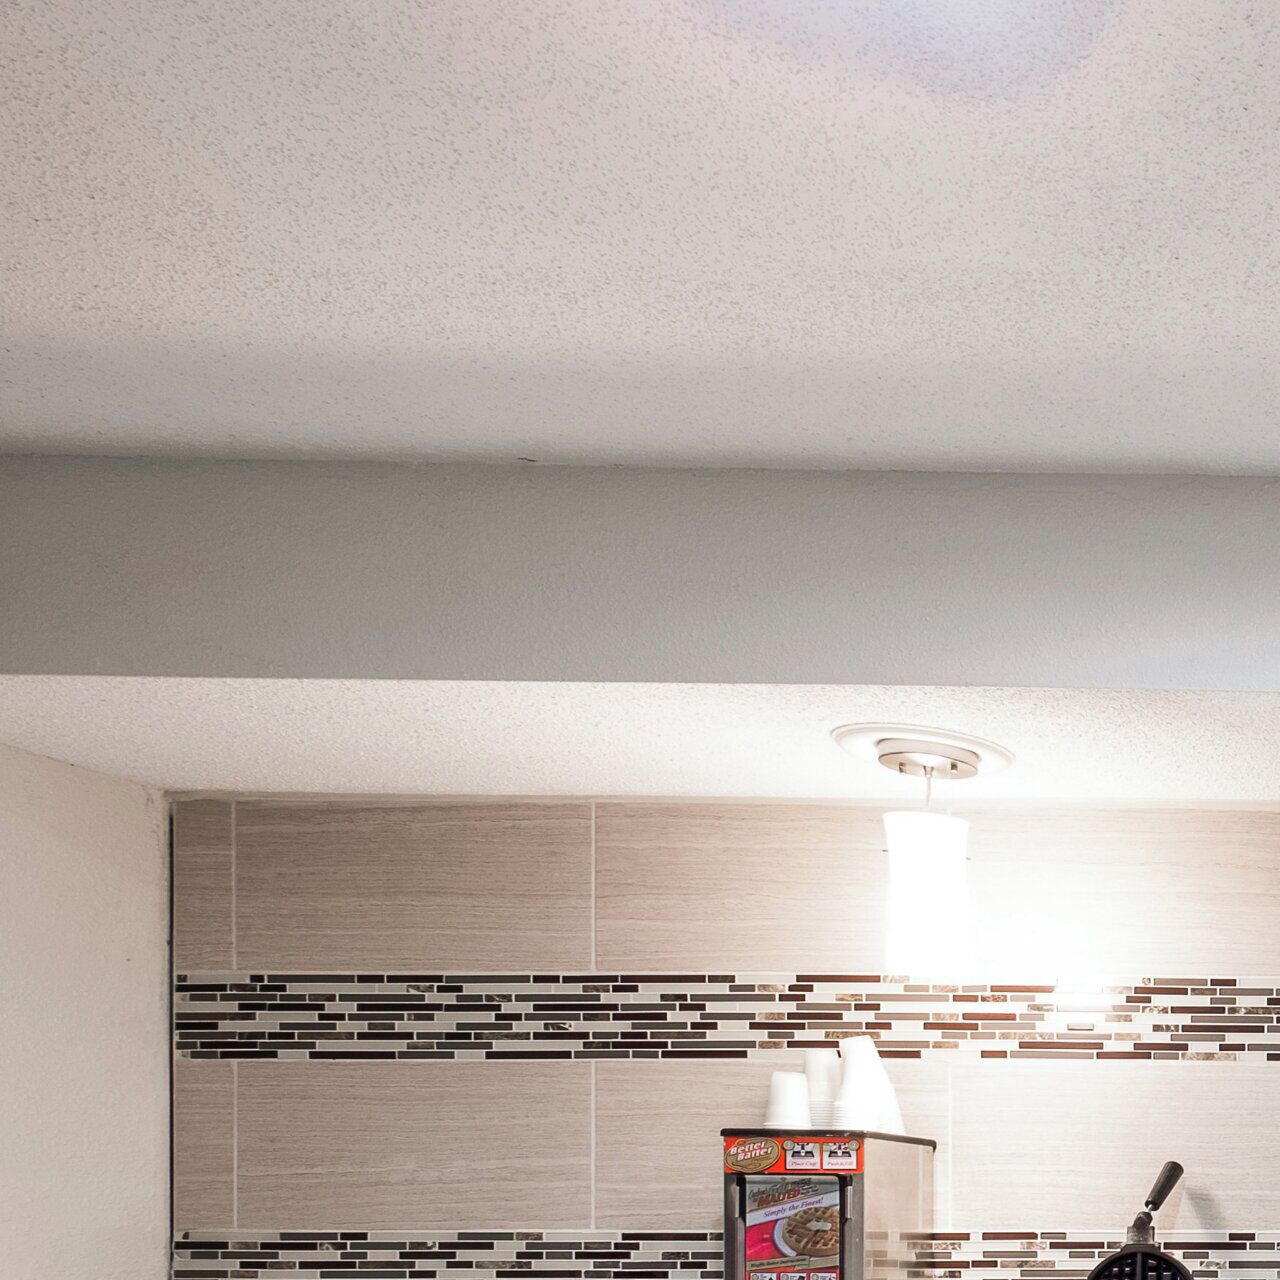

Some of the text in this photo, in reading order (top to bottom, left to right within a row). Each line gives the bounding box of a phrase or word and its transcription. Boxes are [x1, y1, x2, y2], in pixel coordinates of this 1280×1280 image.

[730, 1141, 765, 1155] Better
[737, 1147, 773, 1161] Batter
[763, 1197, 824, 1218] Simply the Finest!
